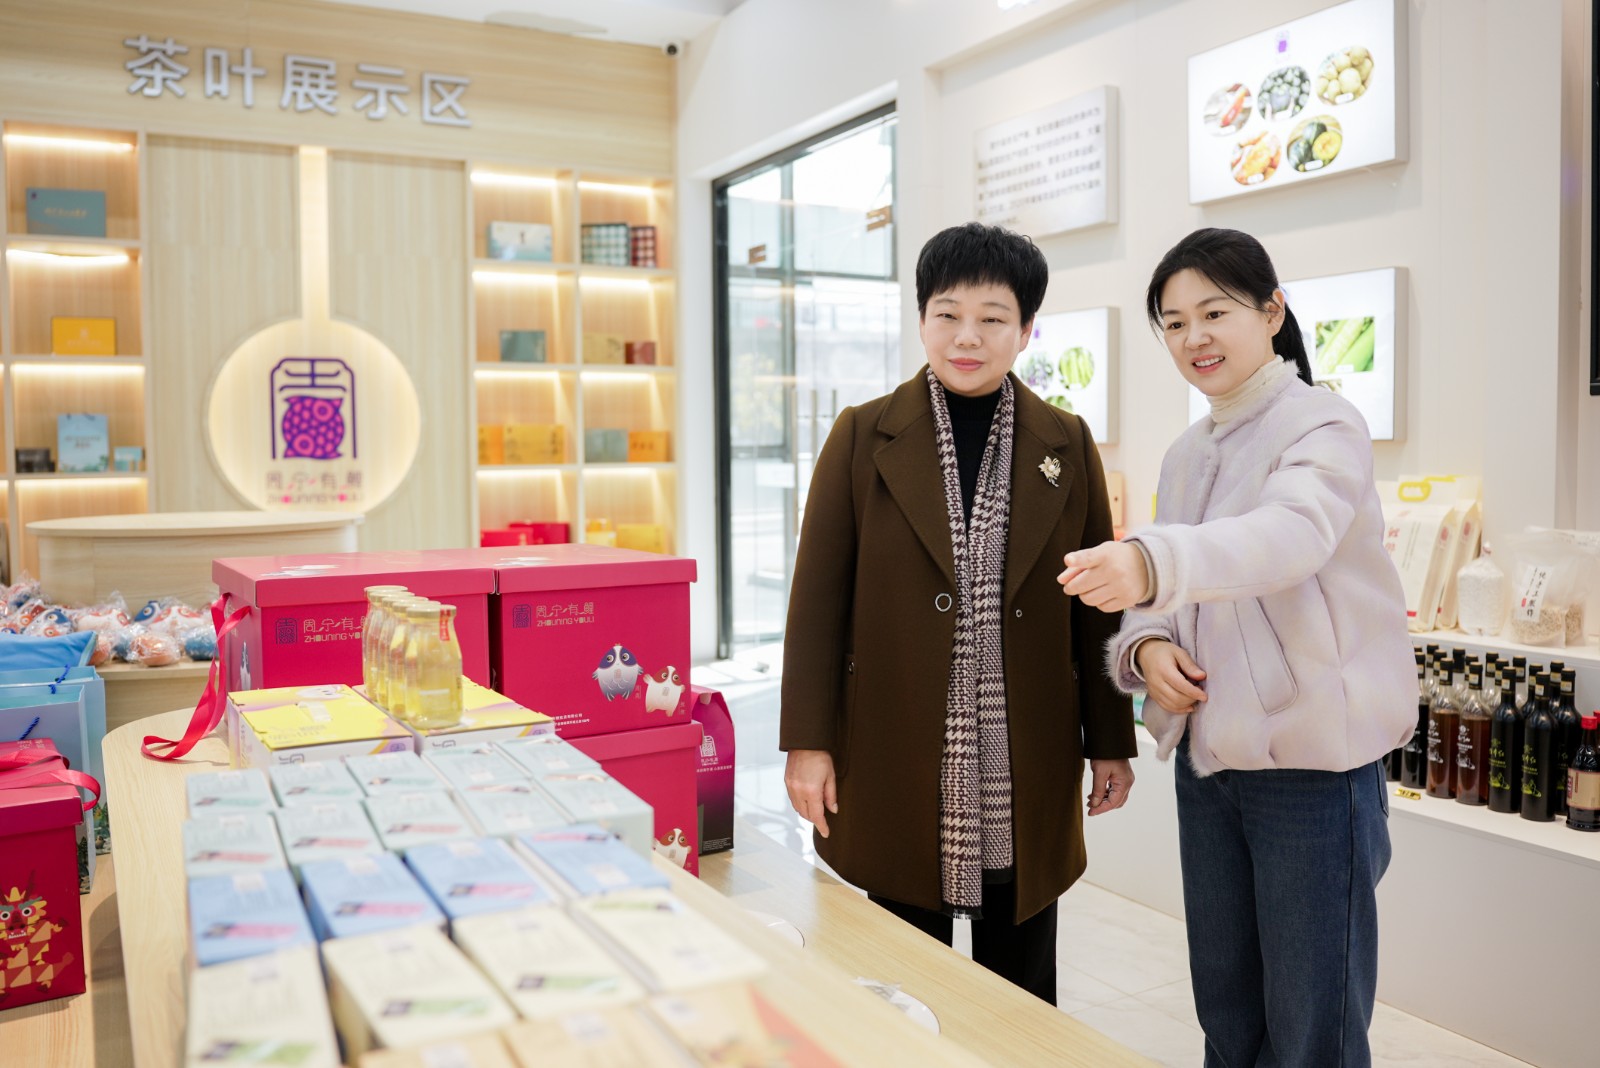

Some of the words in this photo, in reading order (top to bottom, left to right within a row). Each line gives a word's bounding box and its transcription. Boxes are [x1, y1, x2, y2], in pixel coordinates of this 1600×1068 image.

[123, 34, 473, 128] 茶叶展示区
